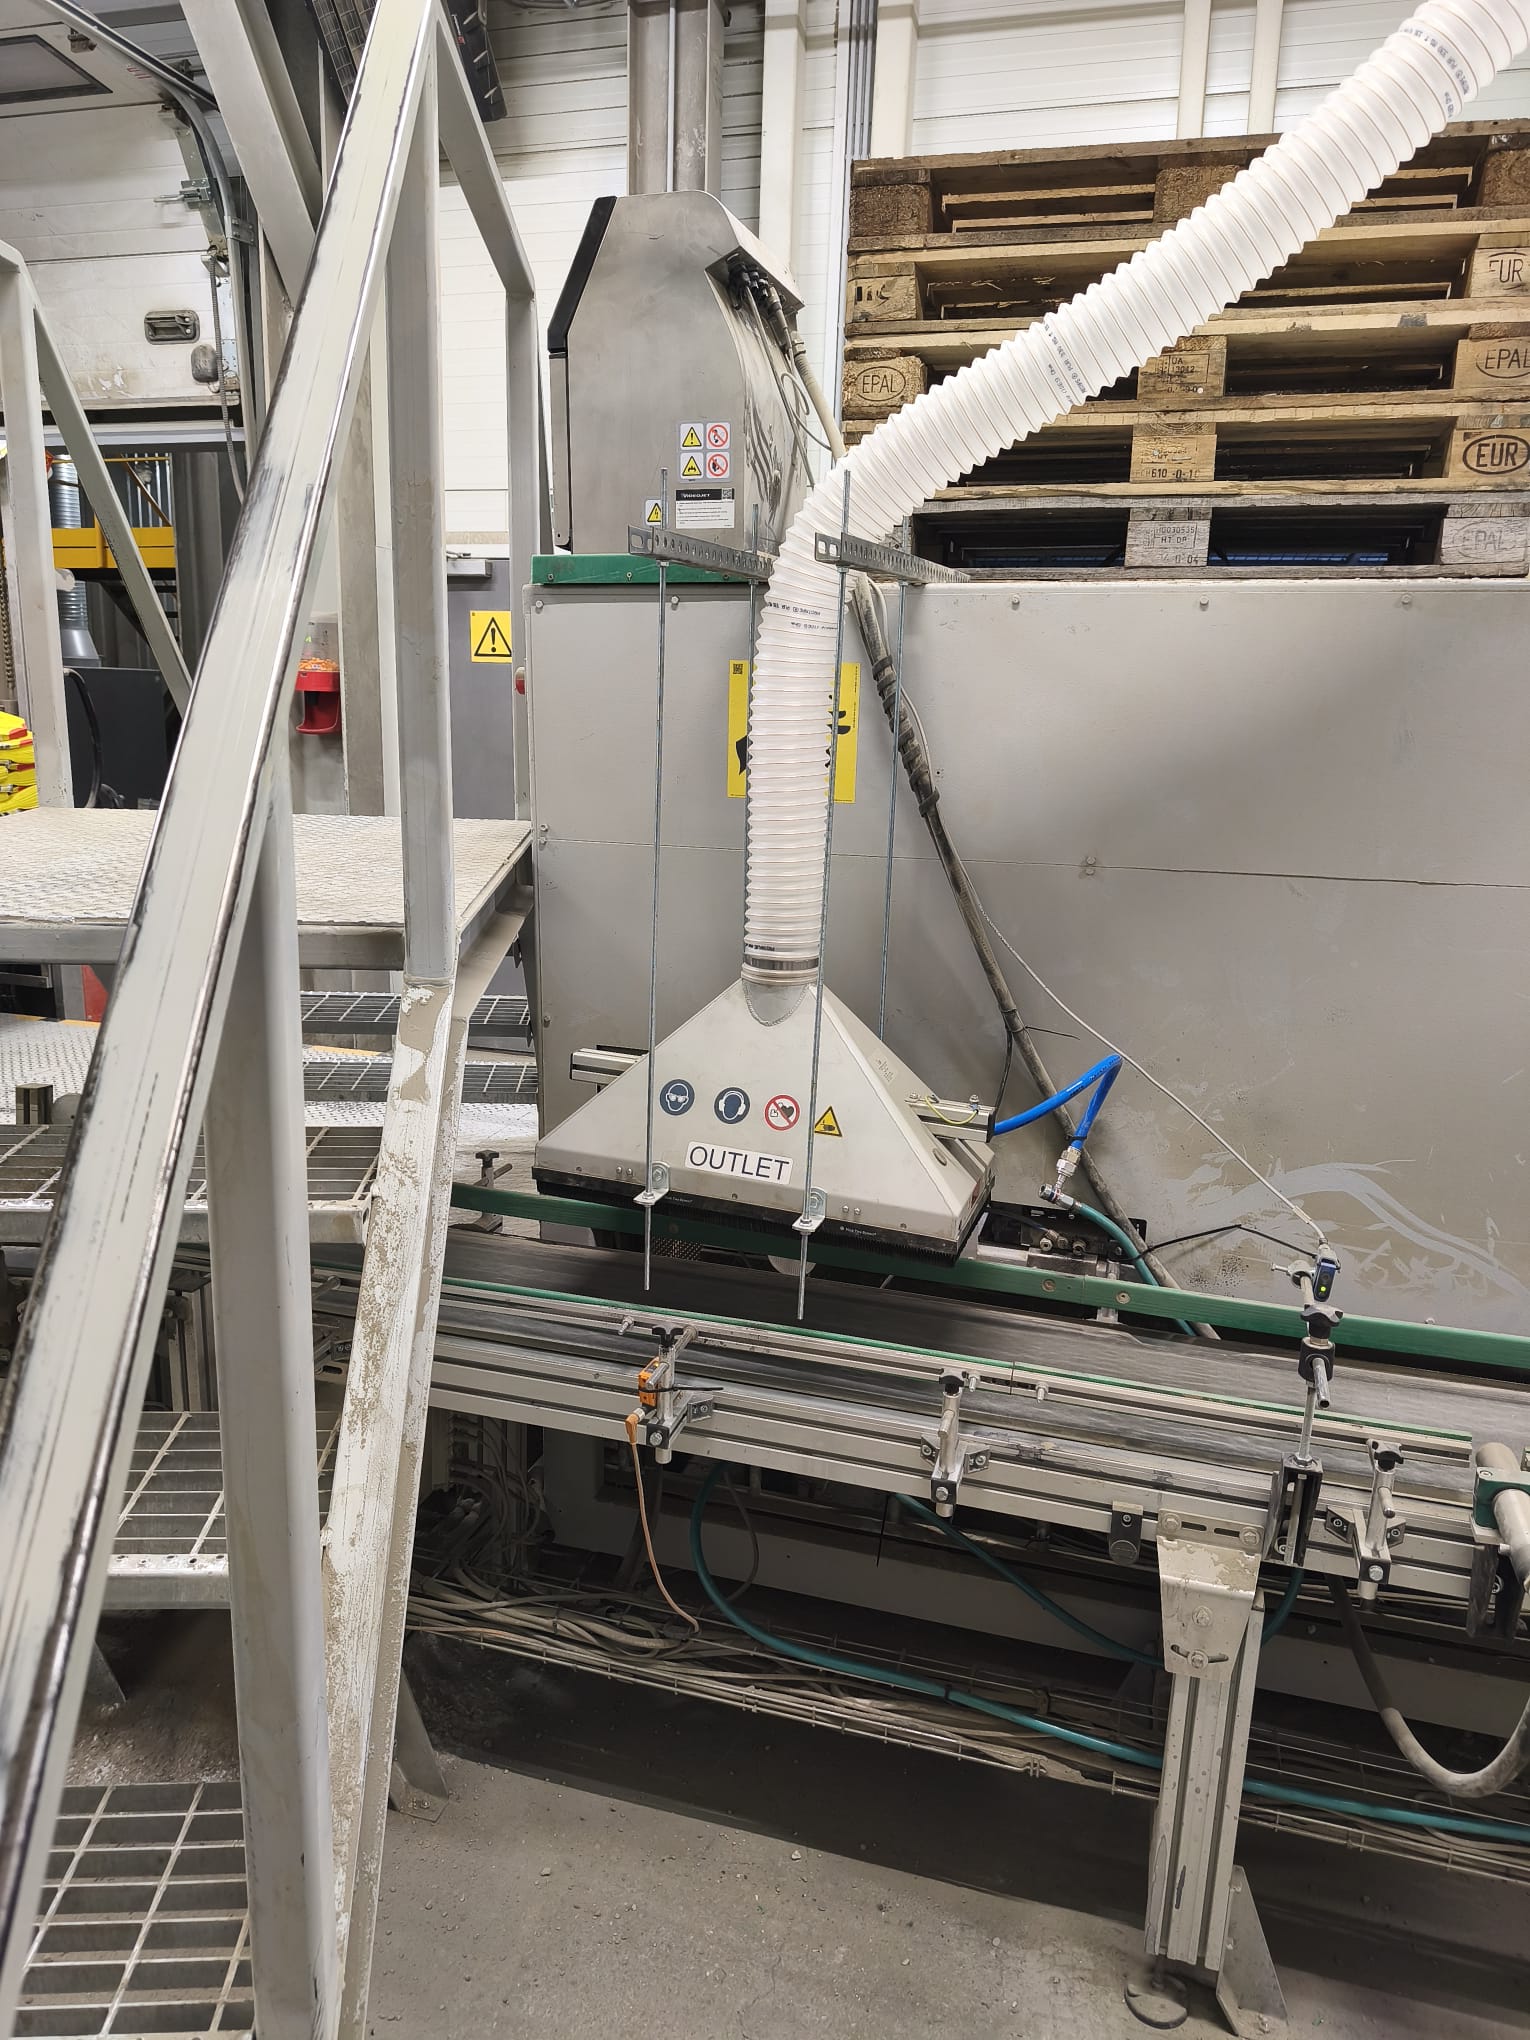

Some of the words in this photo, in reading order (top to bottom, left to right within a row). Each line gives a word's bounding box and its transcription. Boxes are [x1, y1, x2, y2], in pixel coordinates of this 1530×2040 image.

[1484, 348, 1530, 370] EPAL
[862, 374, 898, 394] EPAL
[1476, 443, 1518, 468] EUR
[690, 1146, 790, 1181] OUTLET
